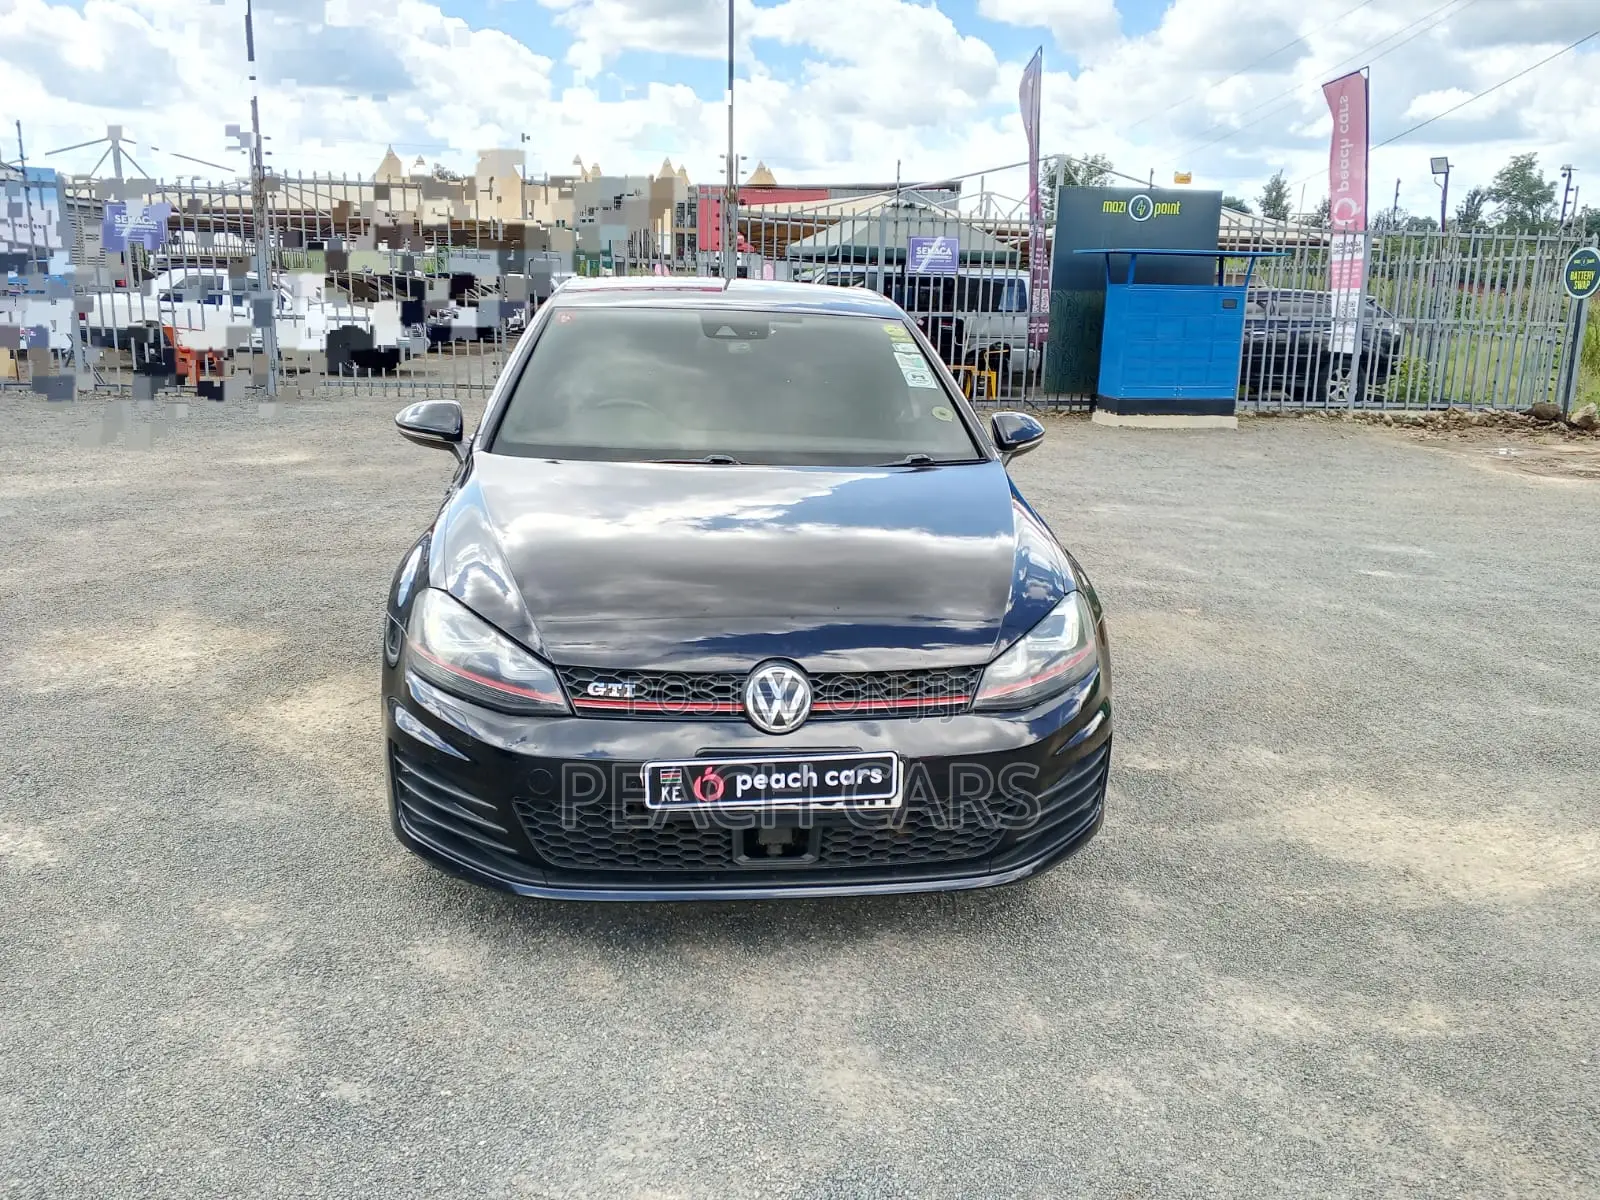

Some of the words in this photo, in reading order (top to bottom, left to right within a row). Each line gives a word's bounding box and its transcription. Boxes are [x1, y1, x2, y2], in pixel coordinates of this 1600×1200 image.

[1153, 200, 1181, 218] point
[1570, 270, 1596, 281] BATTERY
[1573, 280, 1591, 290] SWAP
[587, 682, 636, 699] GTI
[736, 764, 818, 798] peach
[824, 767, 883, 787] cars
[660, 786, 682, 802] KE
